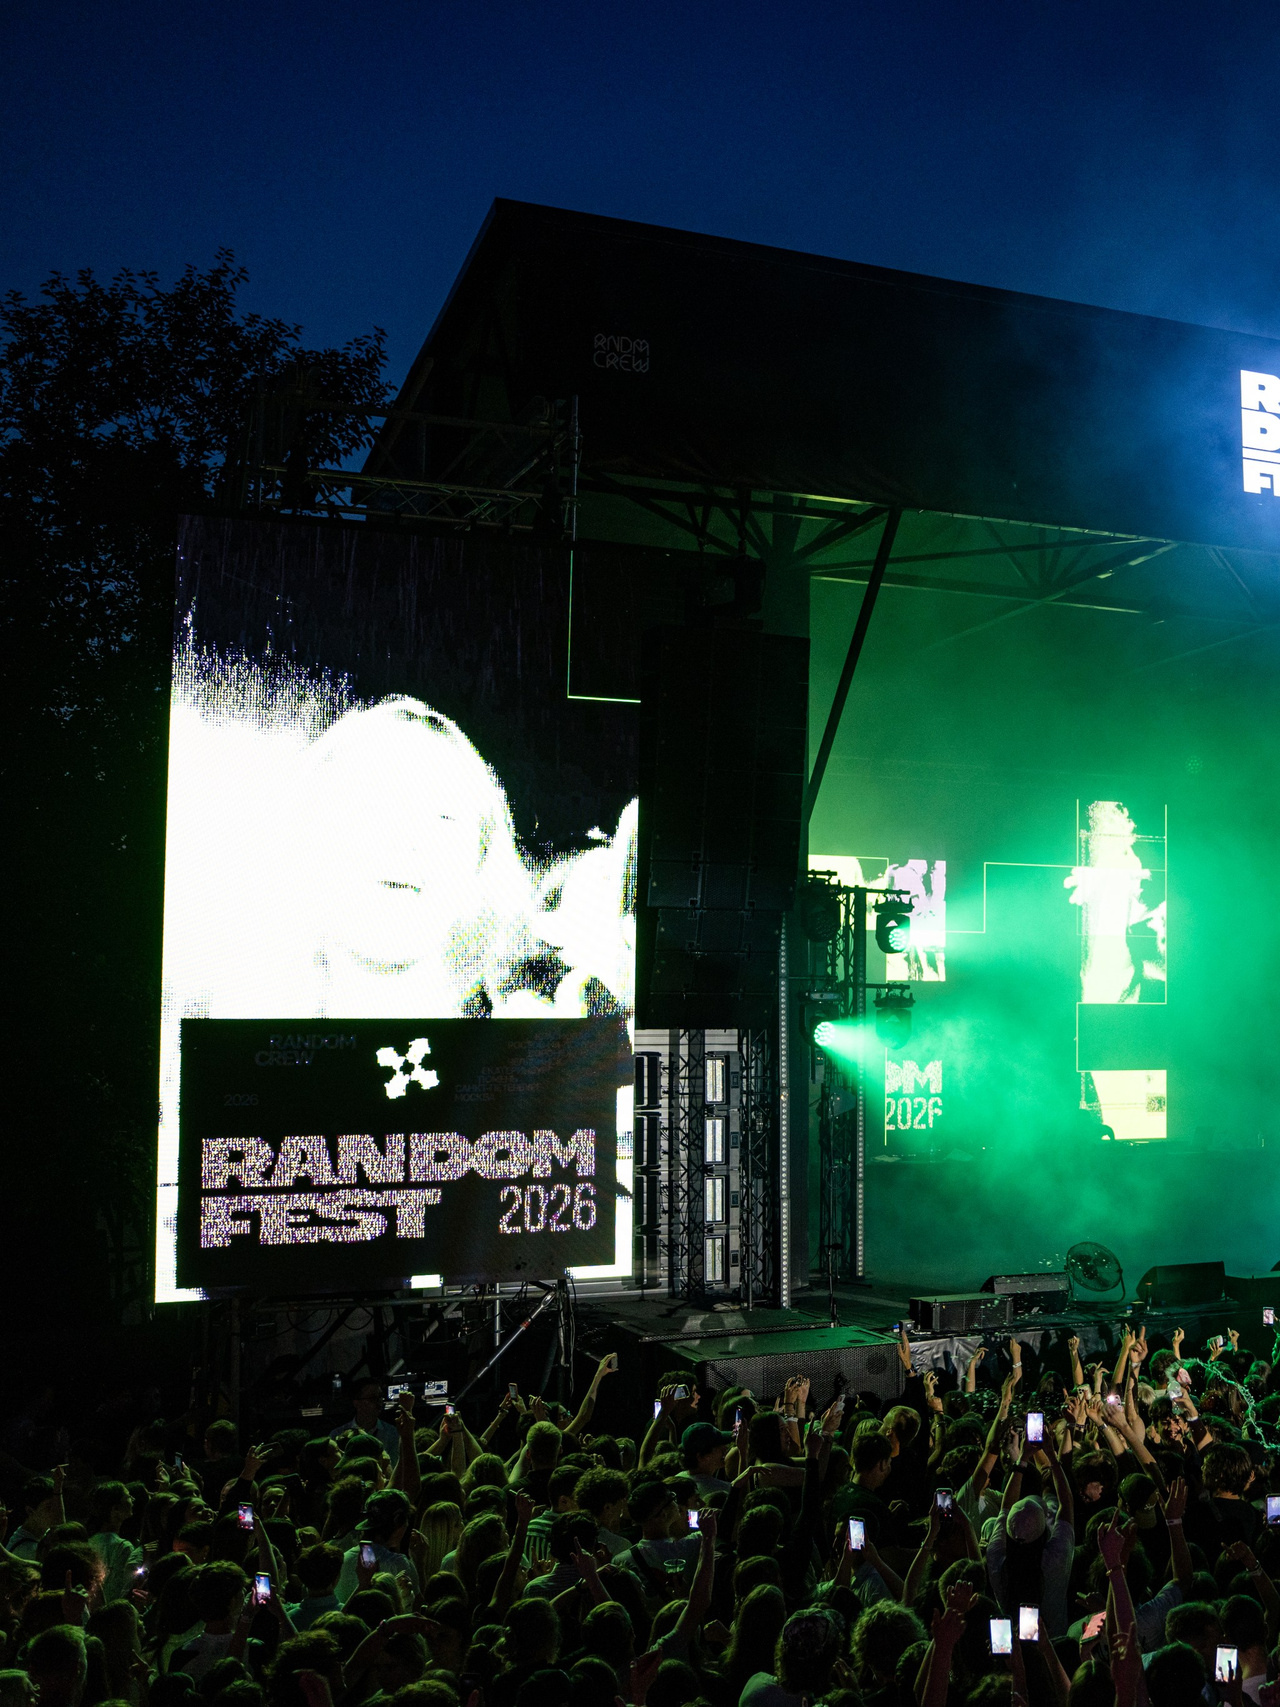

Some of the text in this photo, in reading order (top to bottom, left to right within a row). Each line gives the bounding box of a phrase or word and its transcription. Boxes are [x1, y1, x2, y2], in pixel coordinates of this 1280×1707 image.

[593, 350, 650, 374] CREW
[269, 1034, 358, 1050] RANDOM
[254, 1050, 316, 1067] CREW
[223, 1093, 260, 1106] 2026
[201, 1129, 597, 1190] RANDOM
[201, 1183, 597, 1248] FEST 2026
